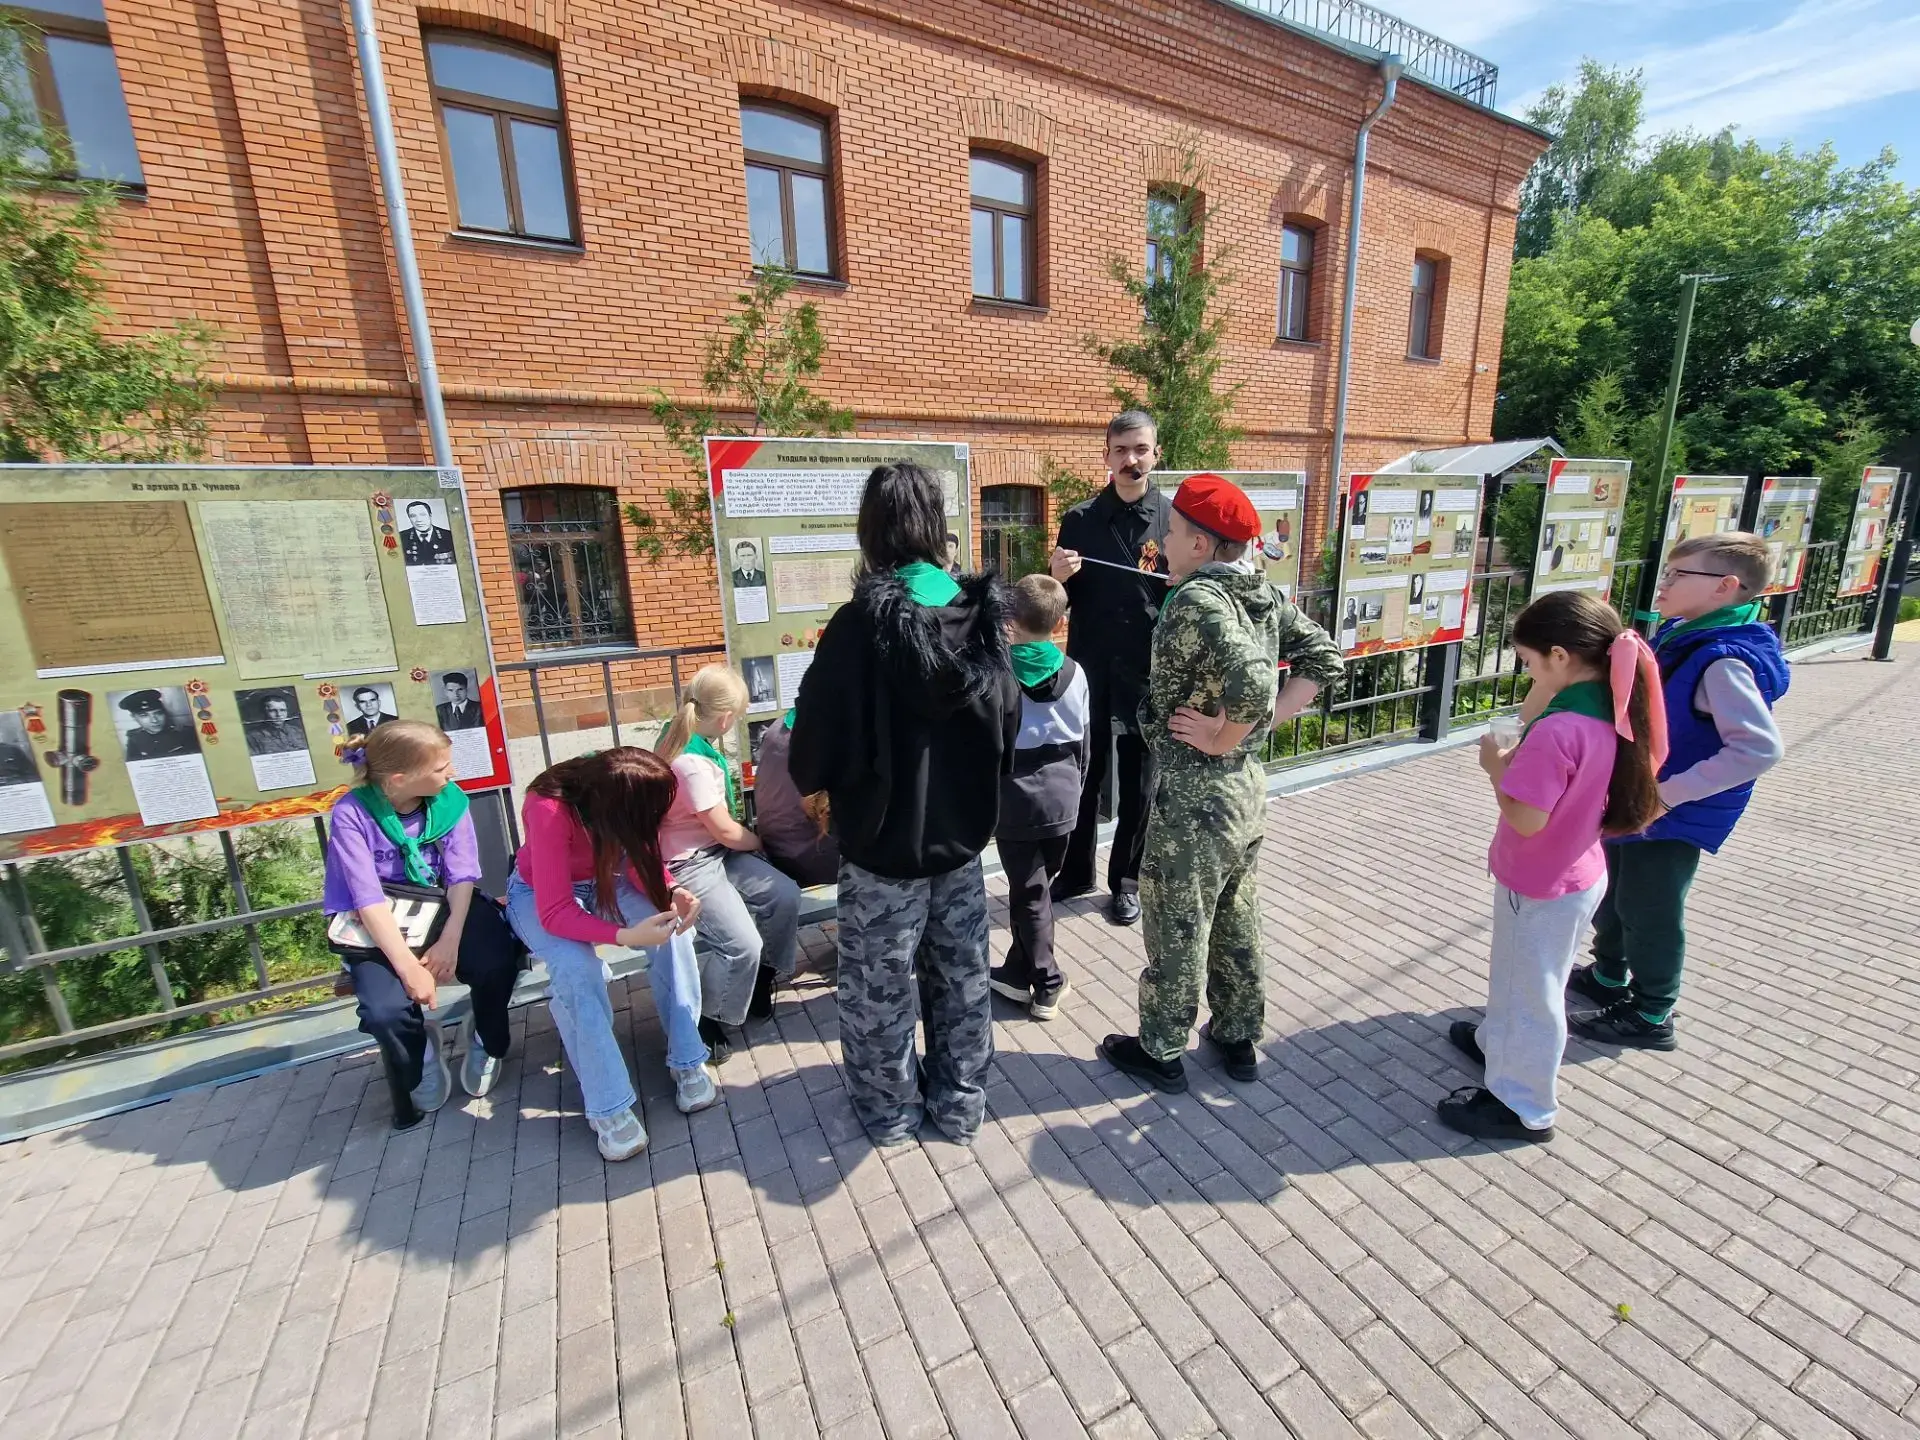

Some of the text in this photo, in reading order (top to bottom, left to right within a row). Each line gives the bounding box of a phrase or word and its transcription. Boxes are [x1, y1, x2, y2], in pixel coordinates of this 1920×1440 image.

[777, 454, 807, 464] Уходили
[820, 456, 844, 464] фронт
[851, 455, 881, 463] погибали
[132, 483, 144, 491] Из
[146, 483, 180, 492] архива
[182, 483, 200, 492] Д.В.
